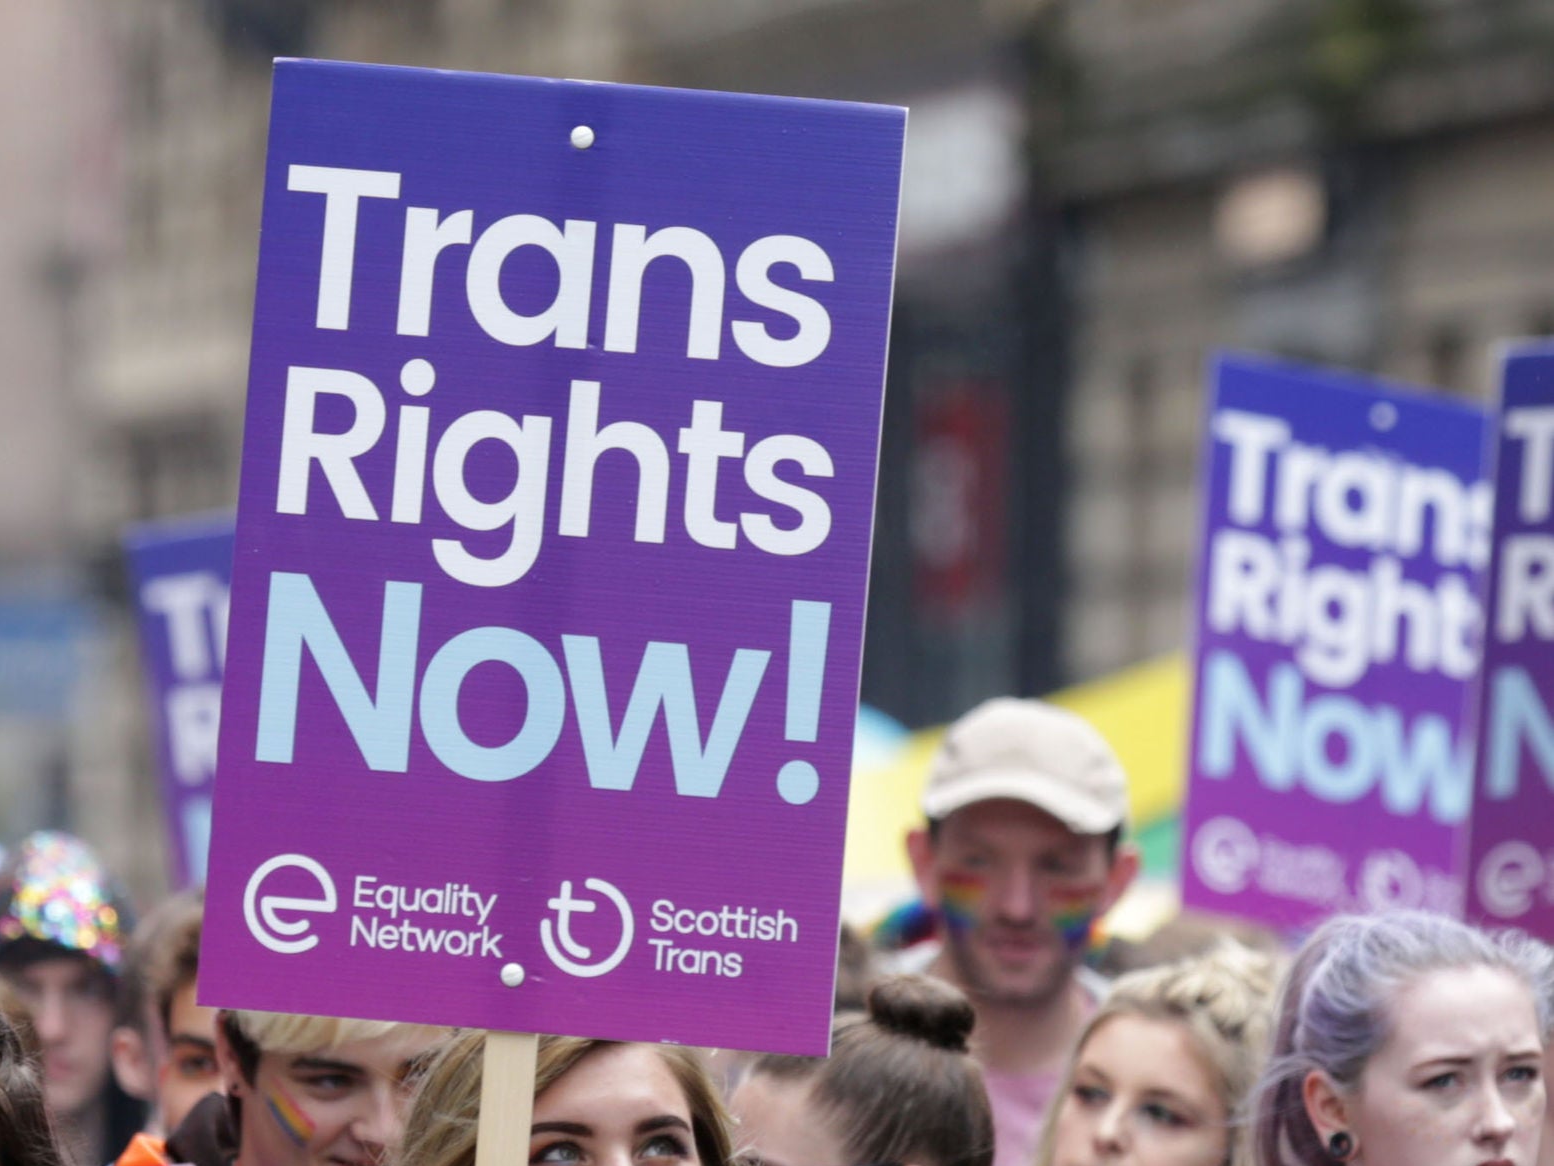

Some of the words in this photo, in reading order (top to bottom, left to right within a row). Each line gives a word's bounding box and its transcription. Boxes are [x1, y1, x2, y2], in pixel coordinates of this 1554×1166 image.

[287, 164, 835, 369] Trans
[277, 357, 835, 588] Rights
[255, 571, 833, 805] Now!
[1208, 530, 1484, 688] Right
[1198, 650, 1474, 828] Now
[350, 913, 503, 959] Network
[352, 876, 499, 925] Equality
[648, 938, 744, 979] Trans
[649, 898, 799, 943] Scottish
